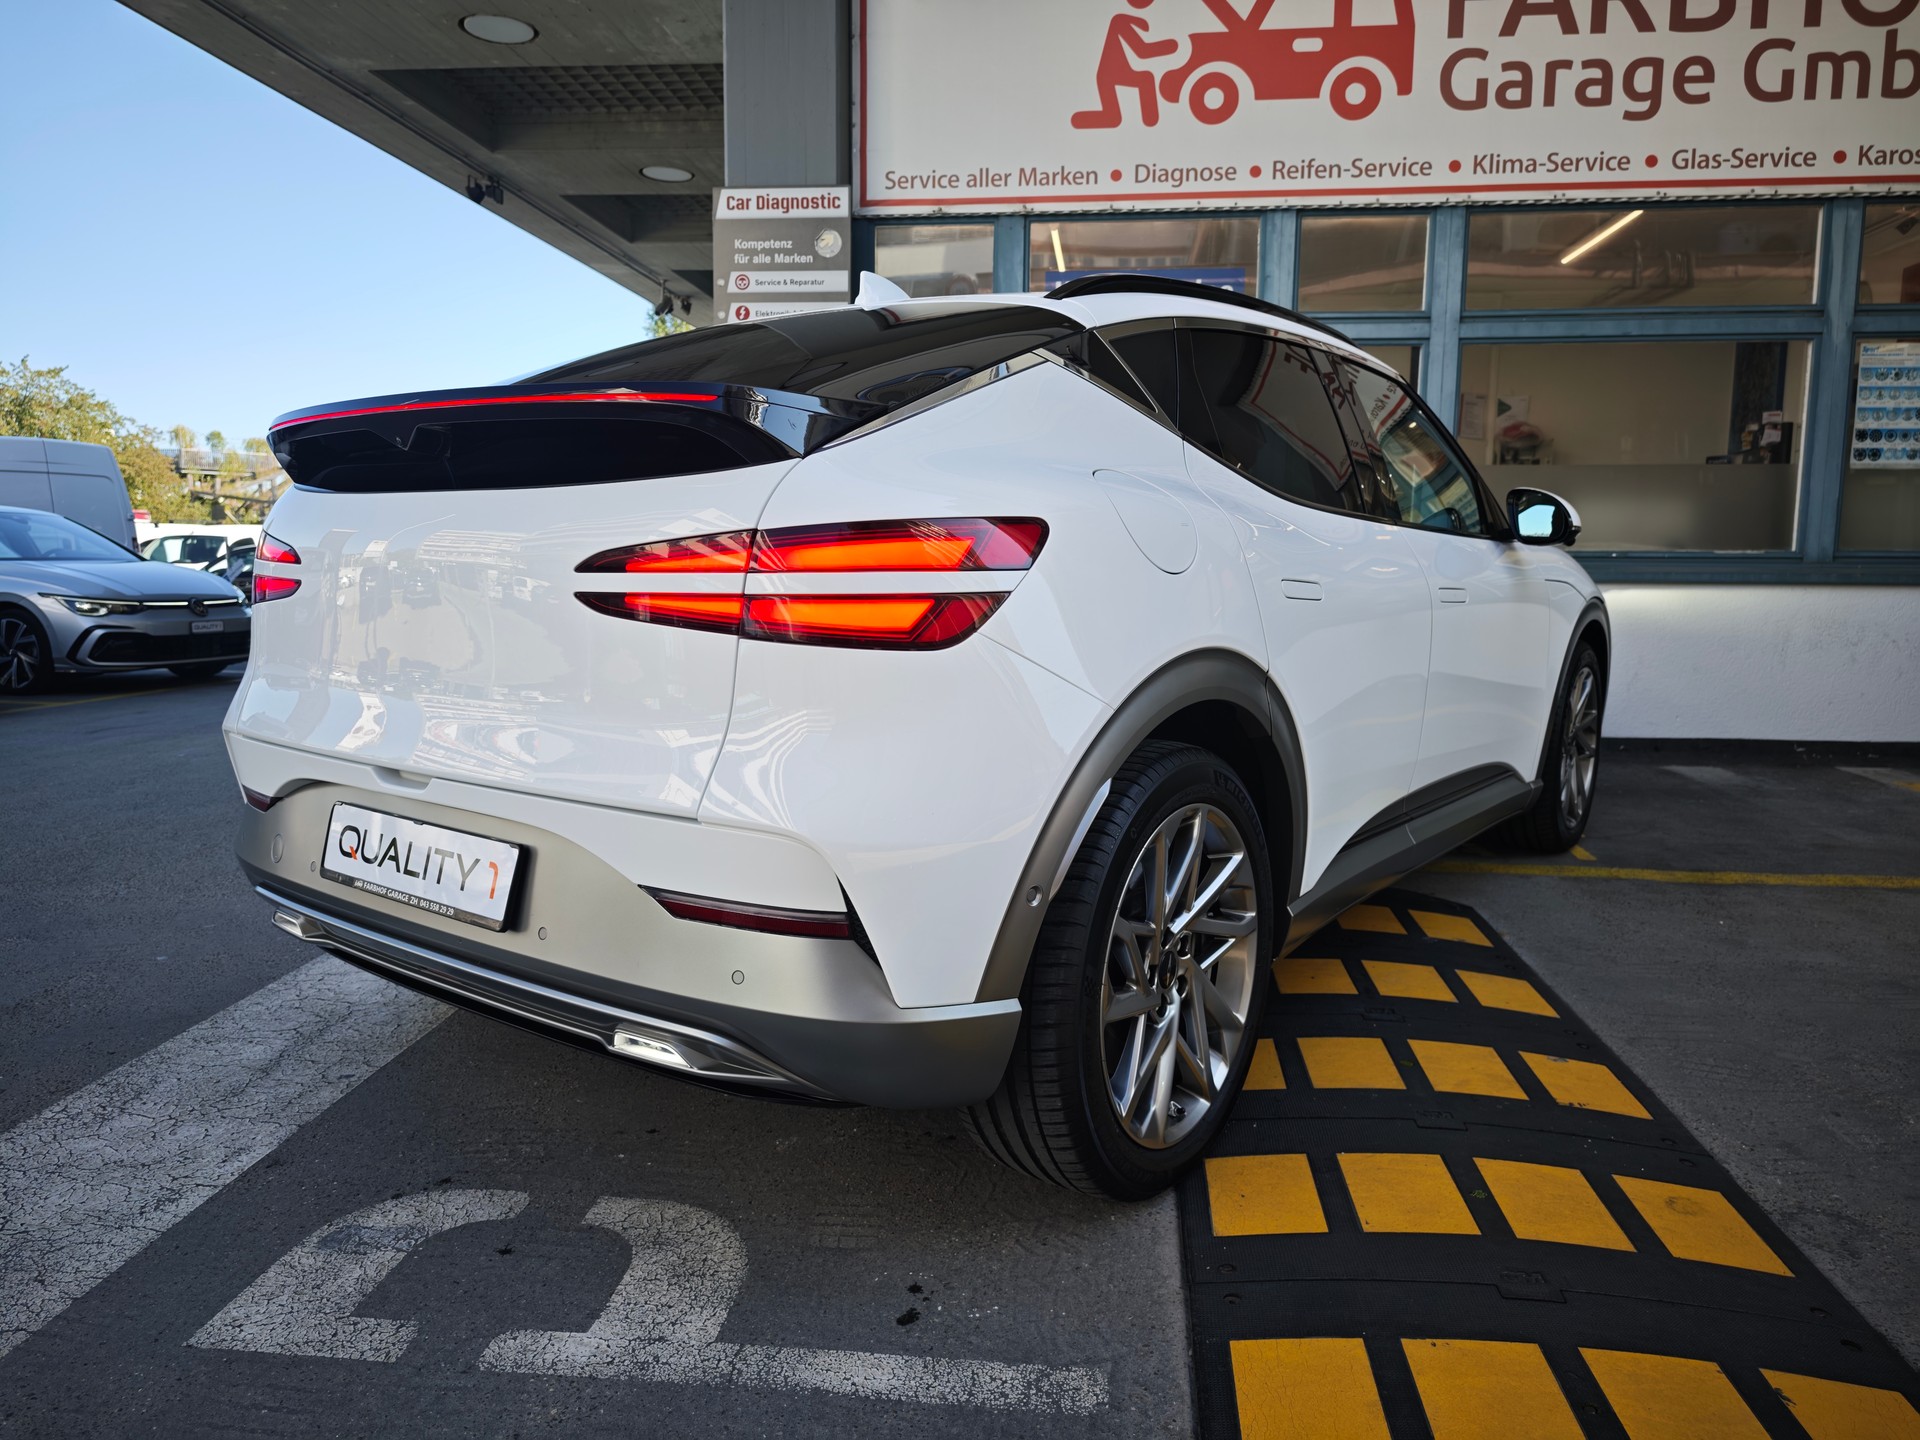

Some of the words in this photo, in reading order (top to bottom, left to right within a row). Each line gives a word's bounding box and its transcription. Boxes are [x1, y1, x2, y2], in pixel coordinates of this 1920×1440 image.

[1440, 47, 1716, 122] Garage
[885, 169, 960, 190] Service
[966, 167, 1012, 188] aller
[1018, 165, 1099, 188] Marken
[1134, 162, 1238, 189] Diagnose
[1271, 156, 1433, 181] Reifen-Service
[1473, 152, 1631, 175] Klima-Service
[1672, 146, 1817, 171] Glas-Service
[726, 195, 752, 211] Car
[756, 192, 841, 214] Diagnostic
[734, 238, 793, 251] Kompetenz
[734, 253, 750, 264] für
[752, 253, 771, 264] alle
[774, 253, 813, 264] Marken
[755, 278, 781, 287] Service
[789, 278, 825, 287] Reparatur
[363, 881, 387, 895] FARBHOF
[387, 889, 409, 902] GARAGE
[410, 896, 418, 905] ZH
[419, 899, 429, 909] 043
[439, 905, 447, 914] 29
[447, 907, 455, 916] 29
